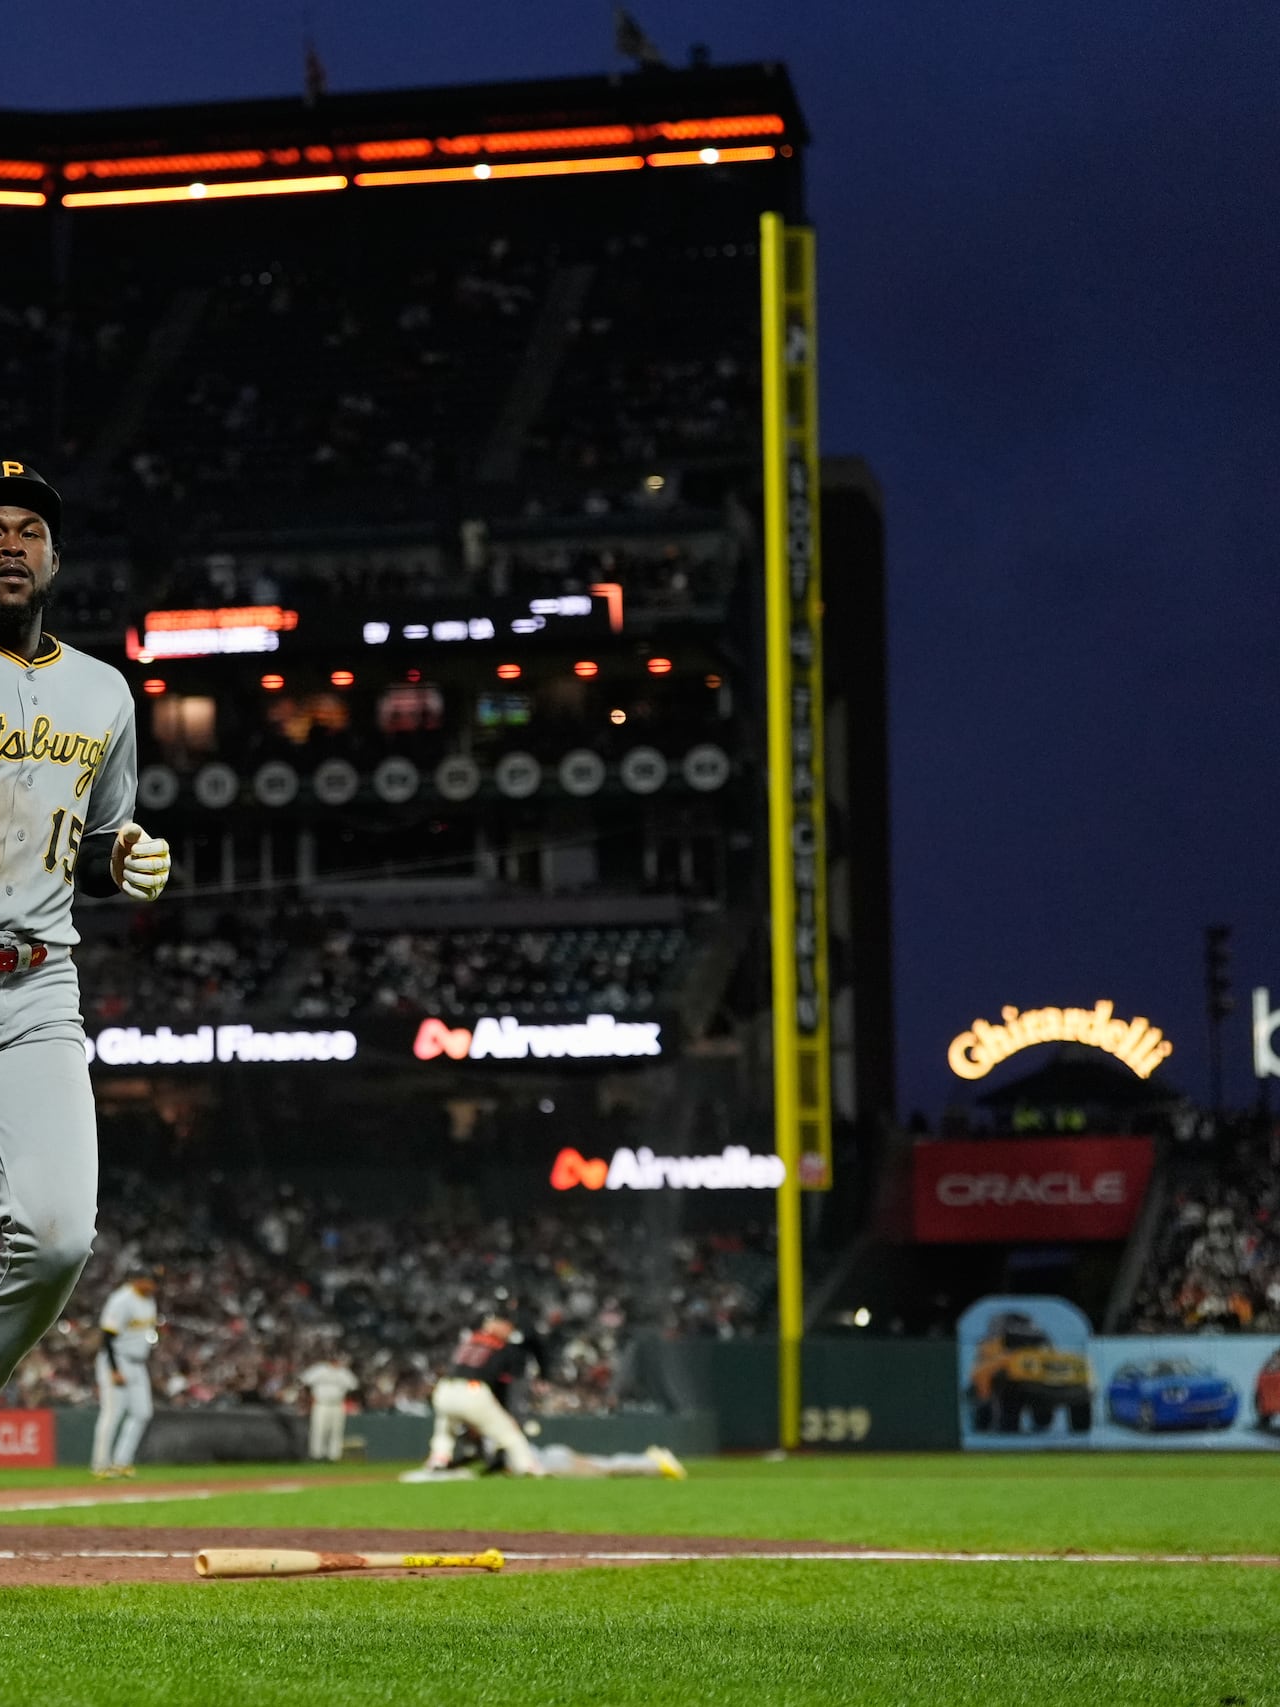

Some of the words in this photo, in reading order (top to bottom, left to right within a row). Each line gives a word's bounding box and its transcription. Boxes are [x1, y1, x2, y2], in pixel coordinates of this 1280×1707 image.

[2, 461, 25, 478] P
[42, 806, 85, 887] 15
[95, 1025, 215, 1066] Global
[216, 1024, 358, 1063] Finance
[470, 1013, 662, 1060] Airwallex
[936, 1170, 1126, 1207] ORACLE
[800, 1406, 872, 1442] 339
